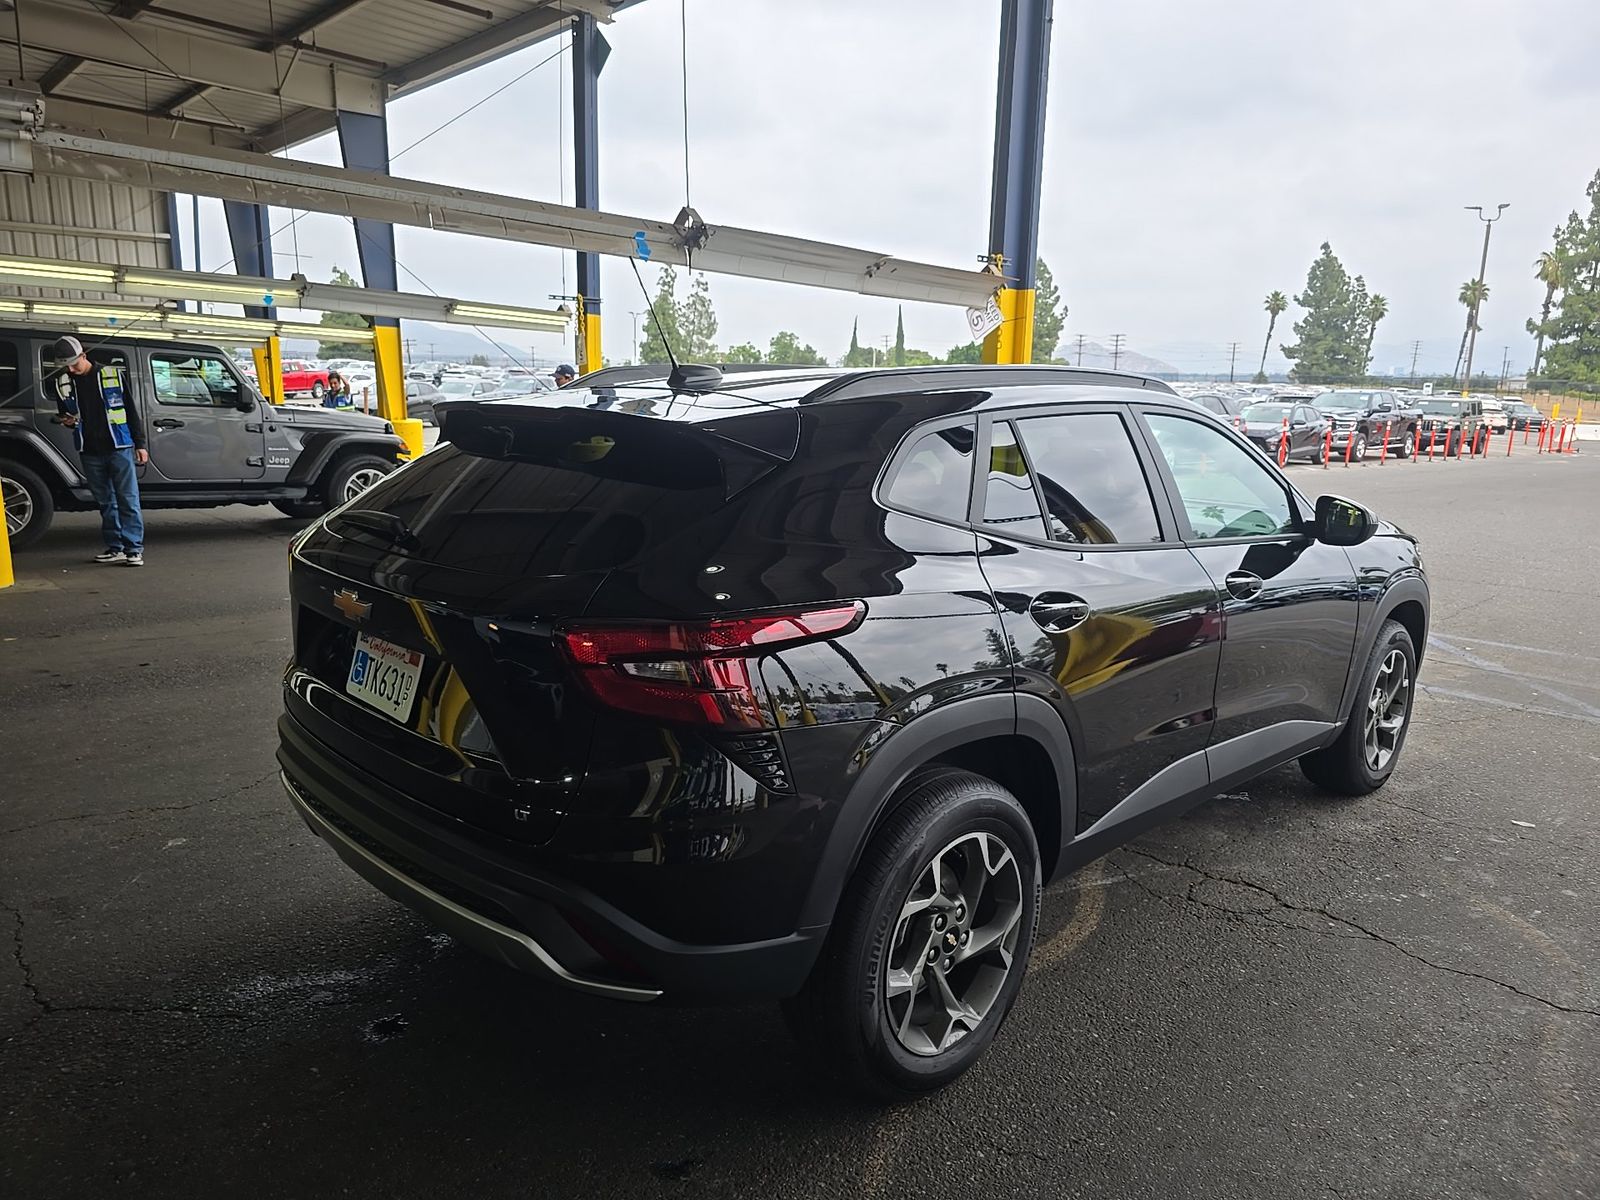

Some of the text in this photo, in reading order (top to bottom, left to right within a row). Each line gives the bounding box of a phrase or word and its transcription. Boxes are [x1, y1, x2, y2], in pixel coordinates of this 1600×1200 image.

[972, 315, 983, 327] 5
[268, 455, 290, 465] Jeep
[368, 636, 407, 660] California
[364, 656, 405, 707] TK631
